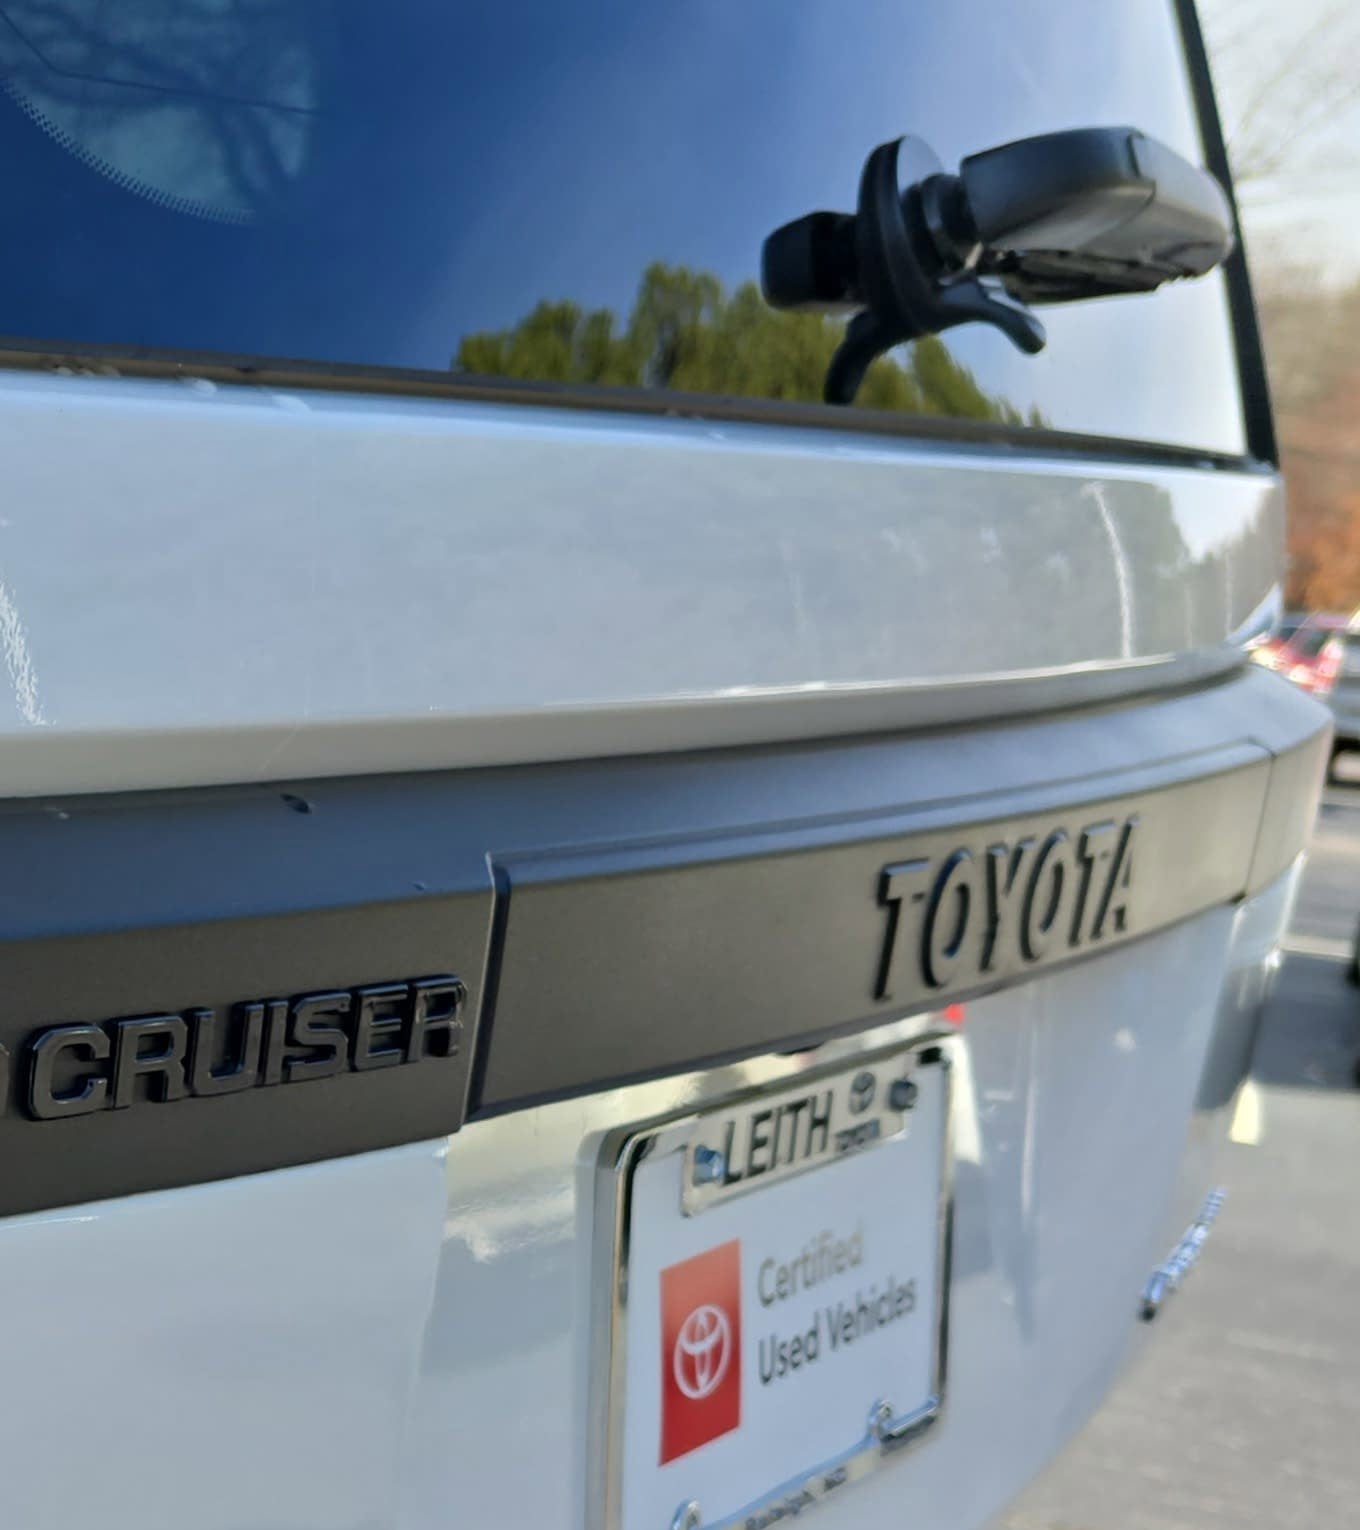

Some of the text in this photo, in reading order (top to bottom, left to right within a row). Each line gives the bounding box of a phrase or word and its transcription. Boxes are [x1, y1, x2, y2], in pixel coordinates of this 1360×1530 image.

[872, 812, 1142, 1002] TOYOTA
[25, 972, 470, 1122] CRUISER
[721, 1090, 834, 1185] LEITH
[757, 1220, 866, 1308] Certified
[758, 1274, 918, 1385] Used Vehicles
